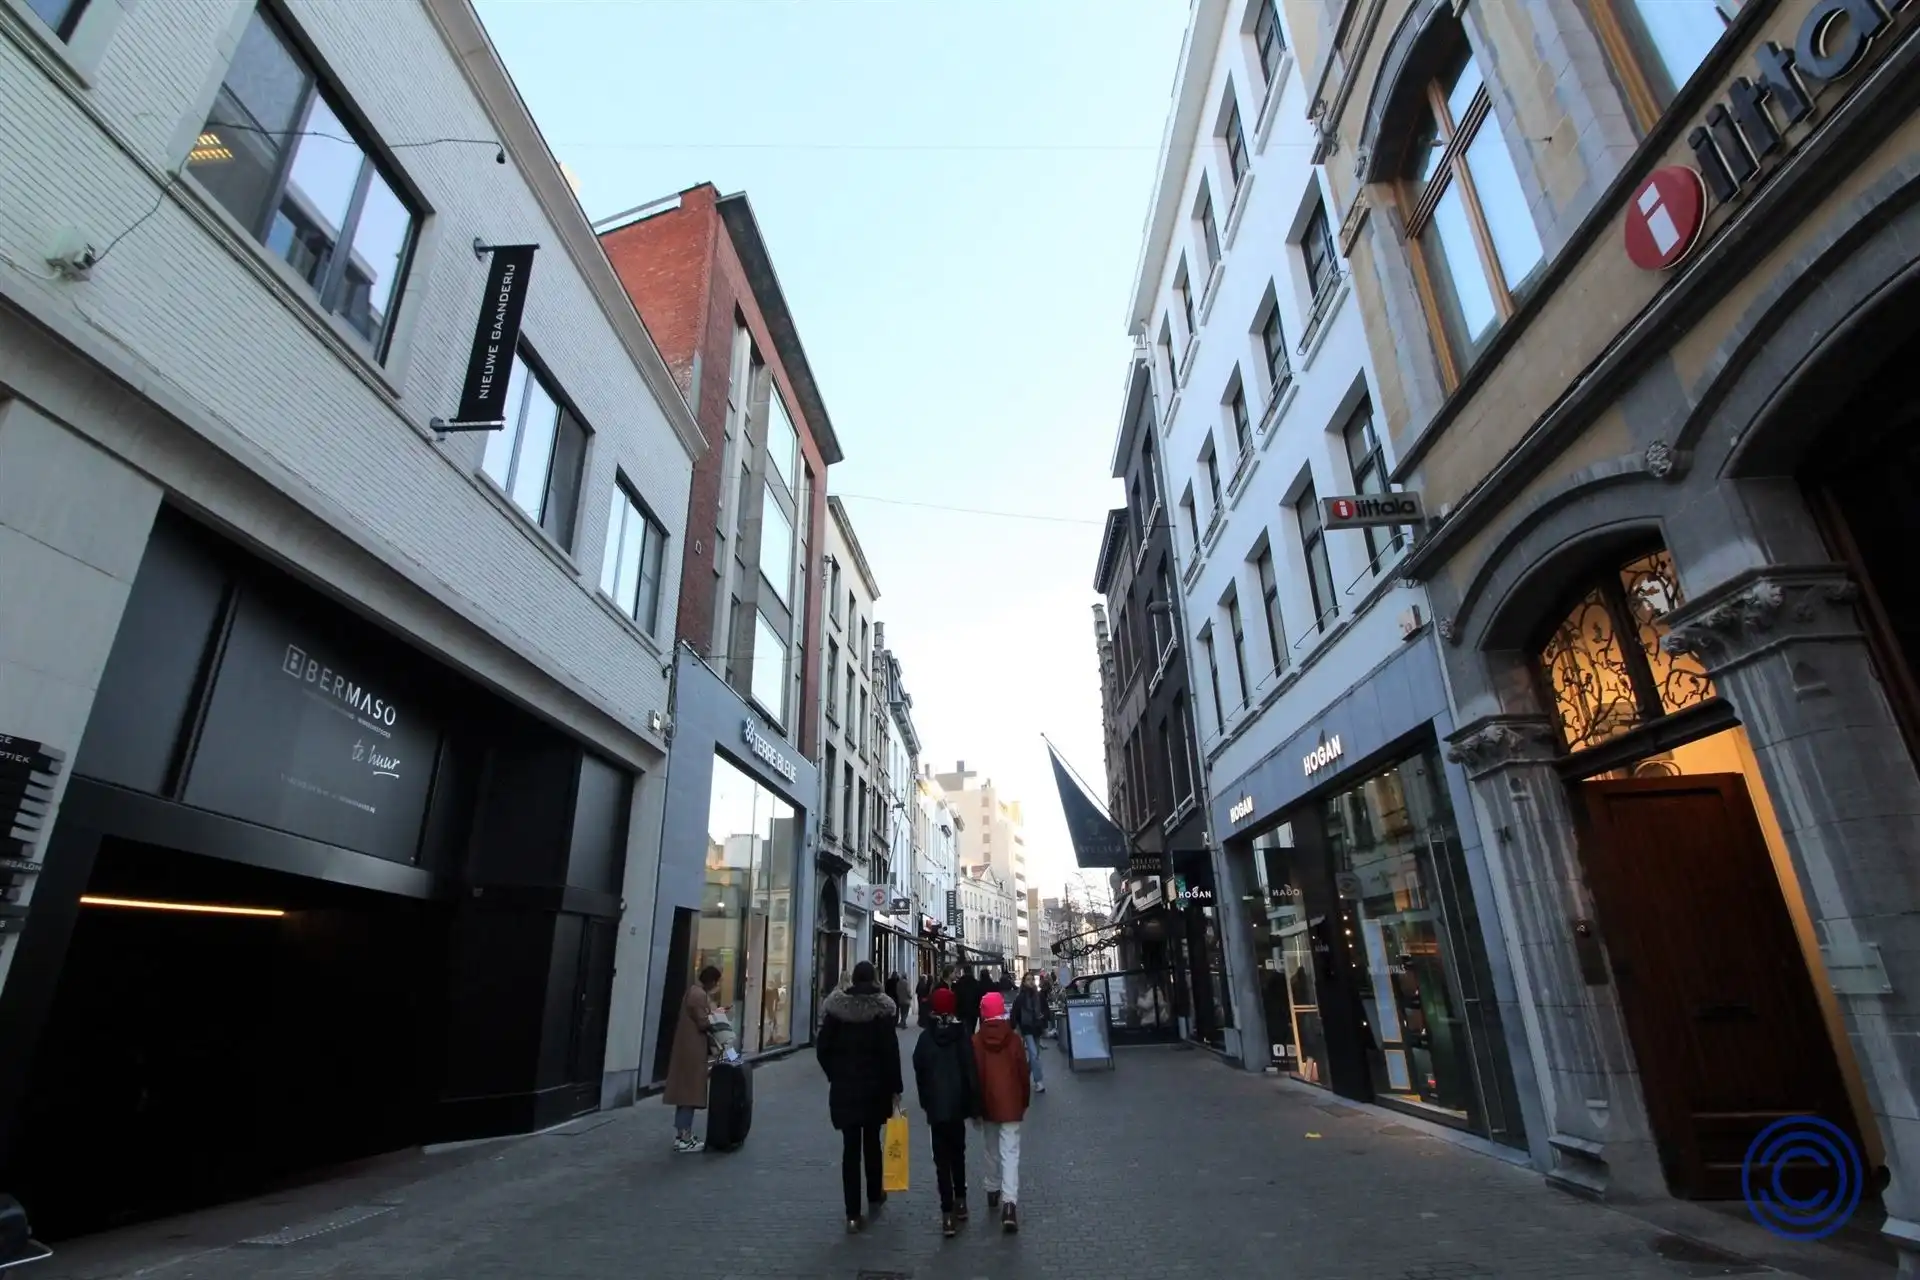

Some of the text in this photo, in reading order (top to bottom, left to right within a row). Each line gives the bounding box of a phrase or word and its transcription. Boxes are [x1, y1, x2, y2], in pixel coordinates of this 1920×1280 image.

[479, 264, 516, 399] NIEUWE GAANDERIJ
[1355, 499, 1416, 517] iittala
[305, 659, 396, 726] BERMASO
[352, 738, 400, 771] te huur
[752, 732, 797, 784] TERRE BLEUE
[1303, 735, 1342, 776] HOGAN
[1230, 796, 1253, 823] HOGAN
[1178, 890, 1212, 899] HOGAN
